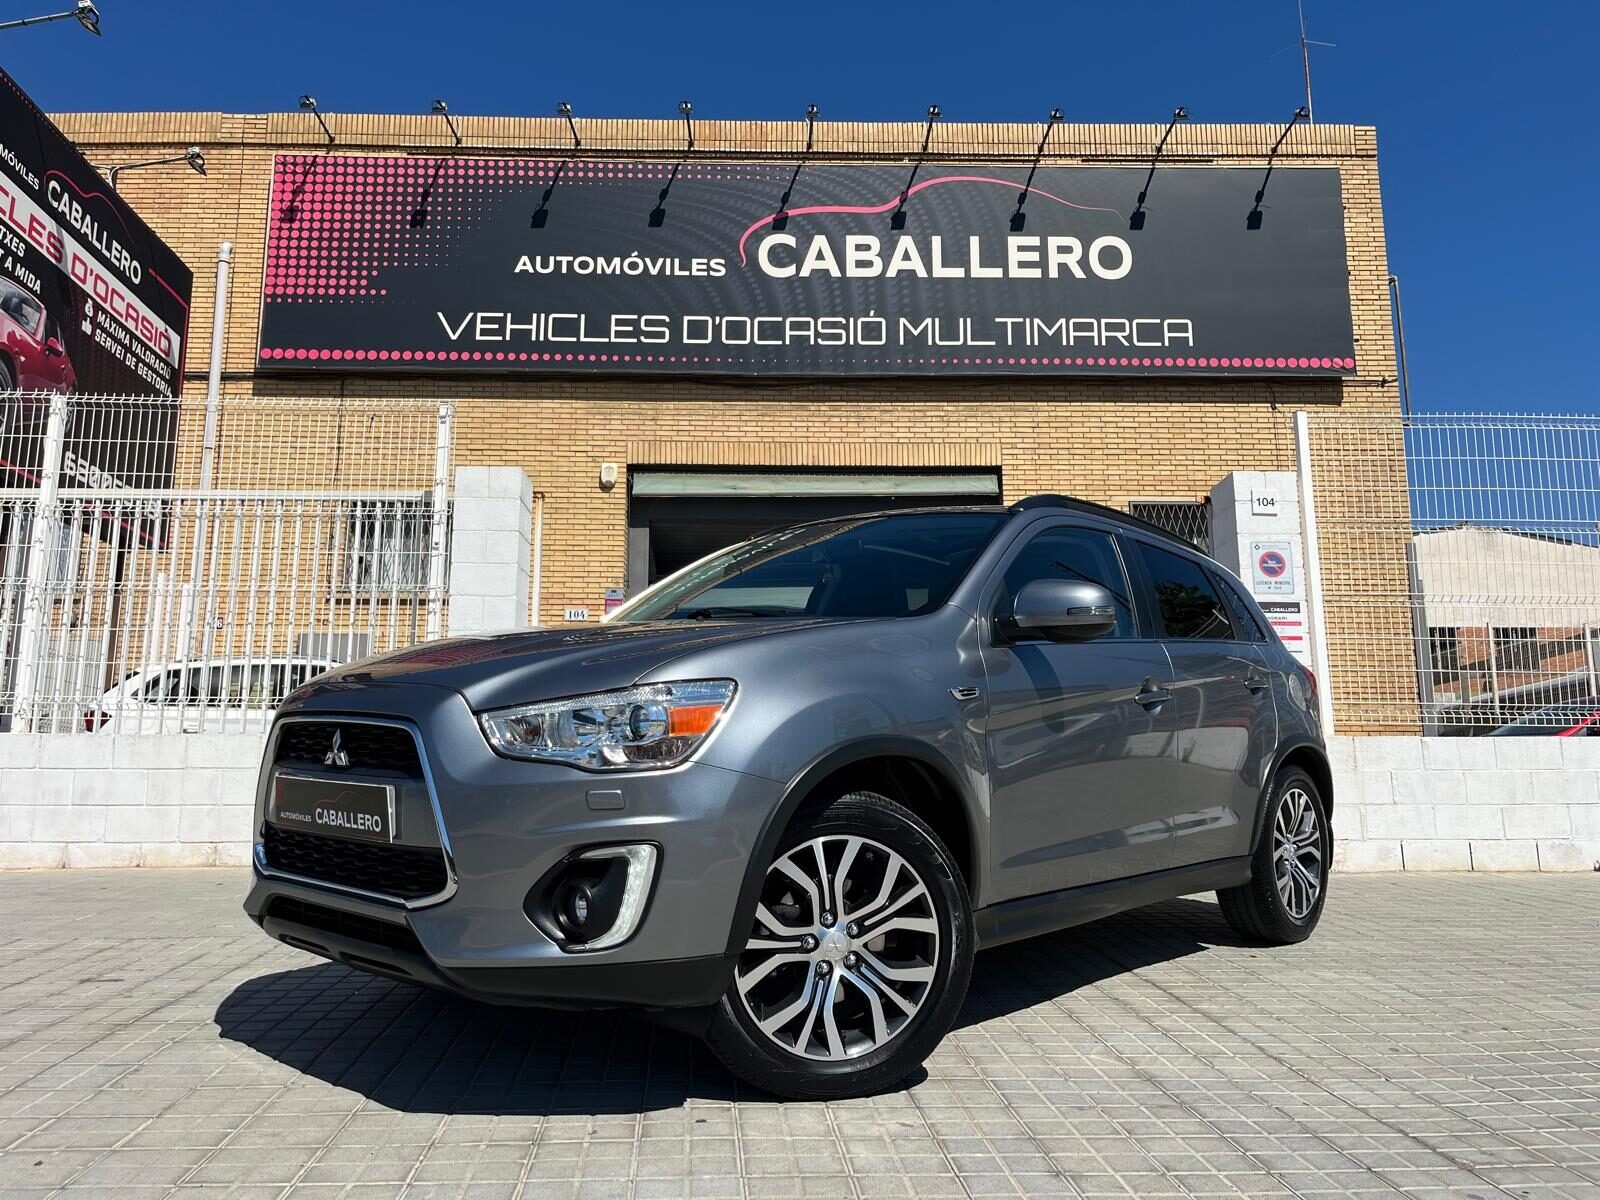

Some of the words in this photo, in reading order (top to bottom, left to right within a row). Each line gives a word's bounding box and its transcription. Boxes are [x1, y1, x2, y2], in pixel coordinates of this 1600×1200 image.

[47, 179, 142, 285] CABALLERO
[514, 251, 726, 277] AUTOMÓVILES
[757, 233, 1134, 280] CABALLERO
[15, 262, 41, 295] MIDA
[70, 251, 171, 358] D'OCASIÓ
[97, 310, 130, 347] MÀXIMA
[132, 338, 172, 380] VALORACIÓ
[437, 311, 670, 344] VEHICLES
[682, 310, 886, 346] D'OCASIÓ
[899, 317, 1194, 347] MULTIMARCA
[95, 329, 125, 361] SERVEI
[125, 354, 136, 370] DE
[137, 363, 172, 398] GESTORIA
[1256, 498, 1275, 507] 104
[568, 610, 585, 619] 104
[280, 810, 312, 822] AUTOMÓVILES
[315, 807, 381, 833] CABALLERO
